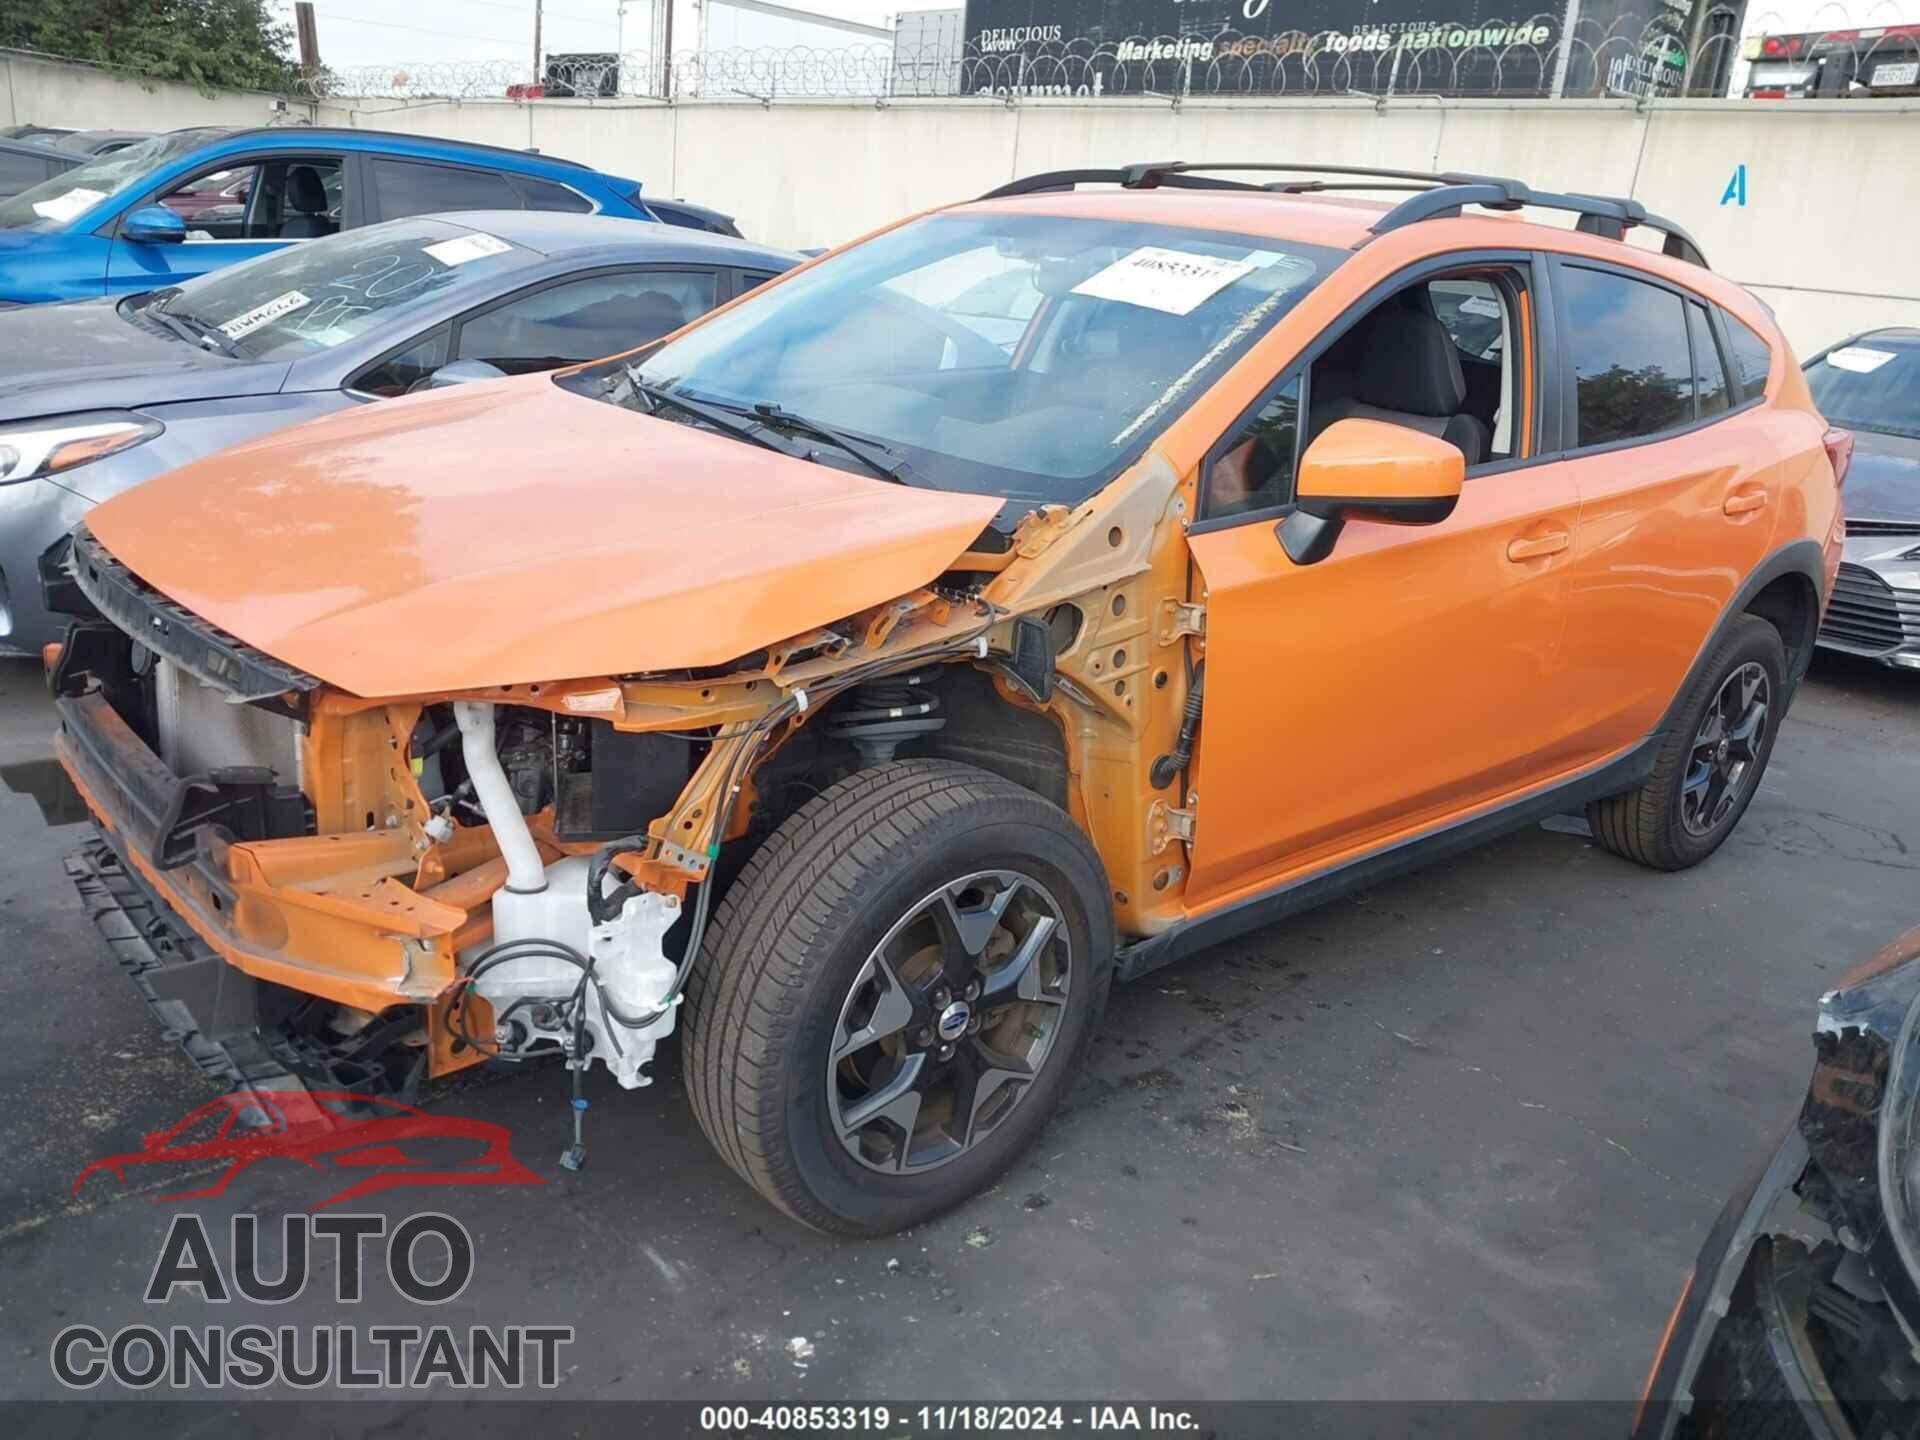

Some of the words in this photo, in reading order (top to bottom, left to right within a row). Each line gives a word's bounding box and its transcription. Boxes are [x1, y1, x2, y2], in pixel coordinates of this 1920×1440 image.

[981, 25, 1062, 43] DELICIOUS
[1352, 21, 1437, 36] DELICIOUS
[1116, 39, 1215, 61] Marketing
[1325, 30, 1392, 52] foods
[1400, 24, 1550, 50] nationwide
